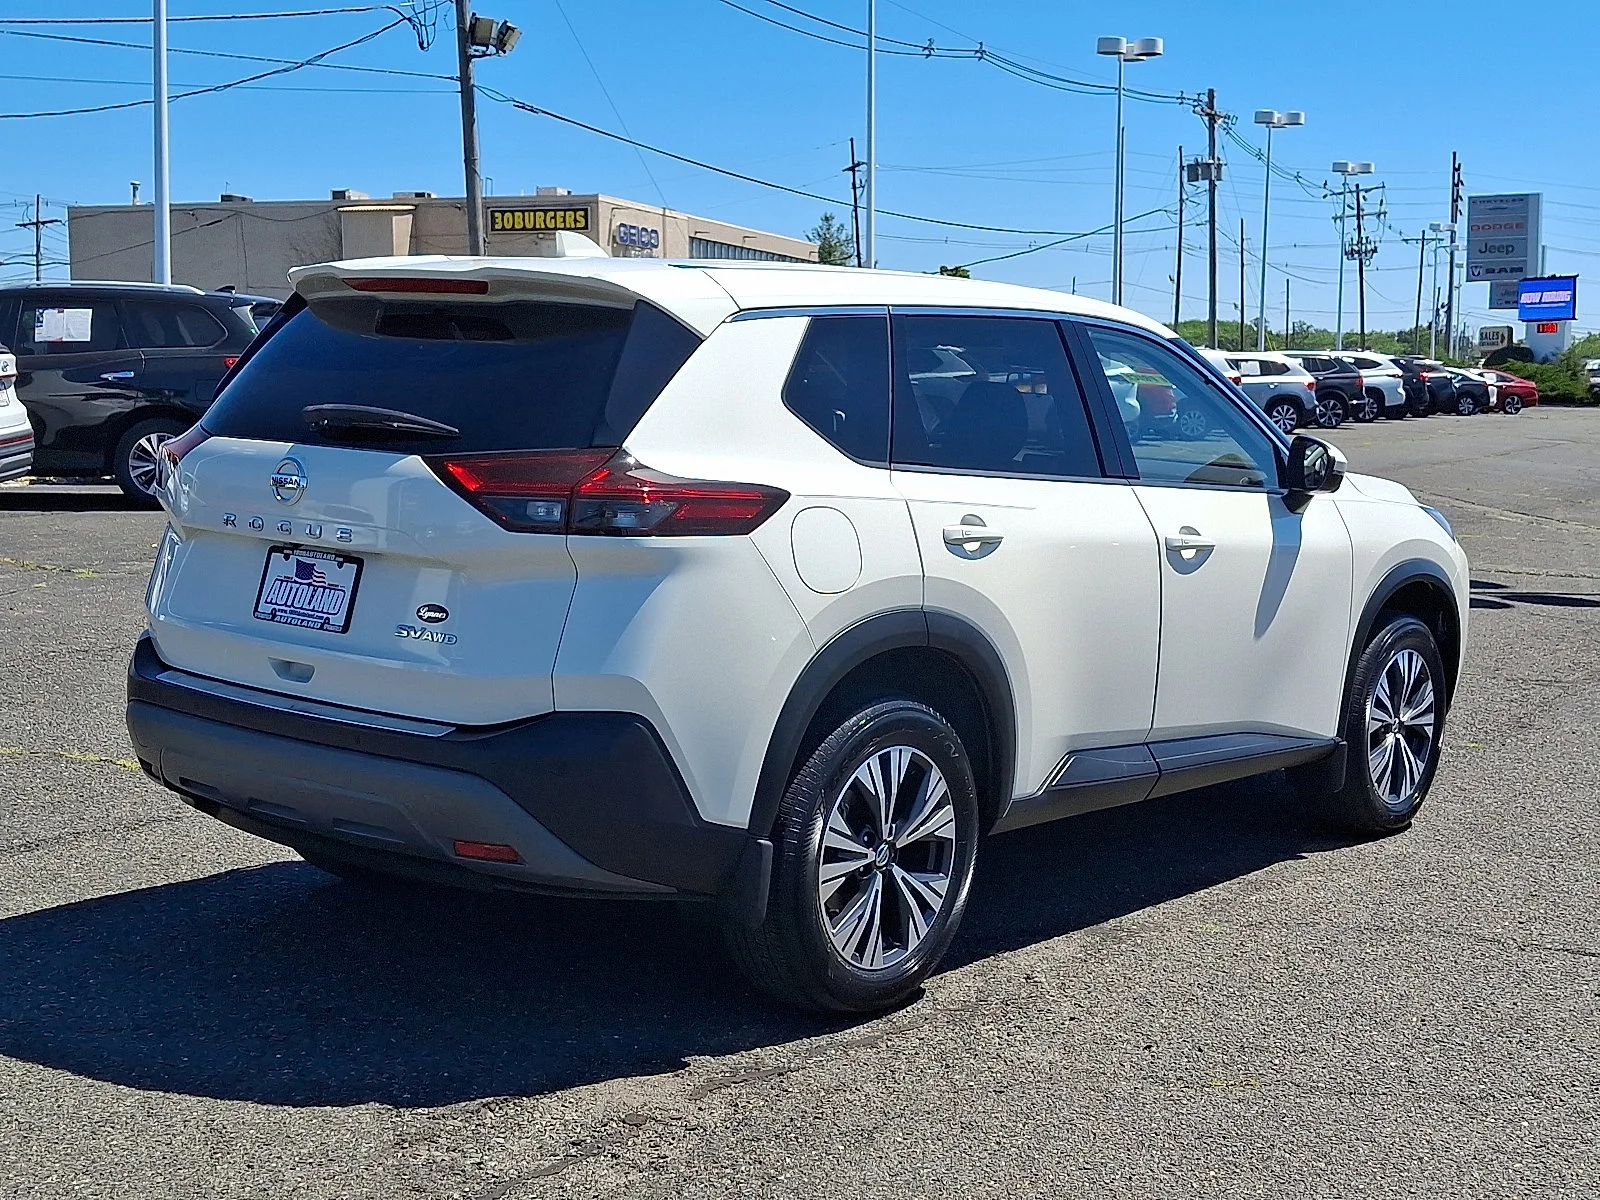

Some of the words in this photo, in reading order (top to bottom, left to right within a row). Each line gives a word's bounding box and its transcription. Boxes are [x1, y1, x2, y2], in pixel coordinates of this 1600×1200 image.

[1470, 222, 1525, 231] DODGE
[618, 222, 660, 249] GEICO
[1478, 242, 1515, 256] Jeep
[1480, 331, 1500, 341] SALES
[271, 476, 301, 487] NISSAN
[223, 512, 353, 543] ROGUE
[266, 580, 344, 614] AUTOLAND
[274, 615, 322, 629] AUTOLAND
